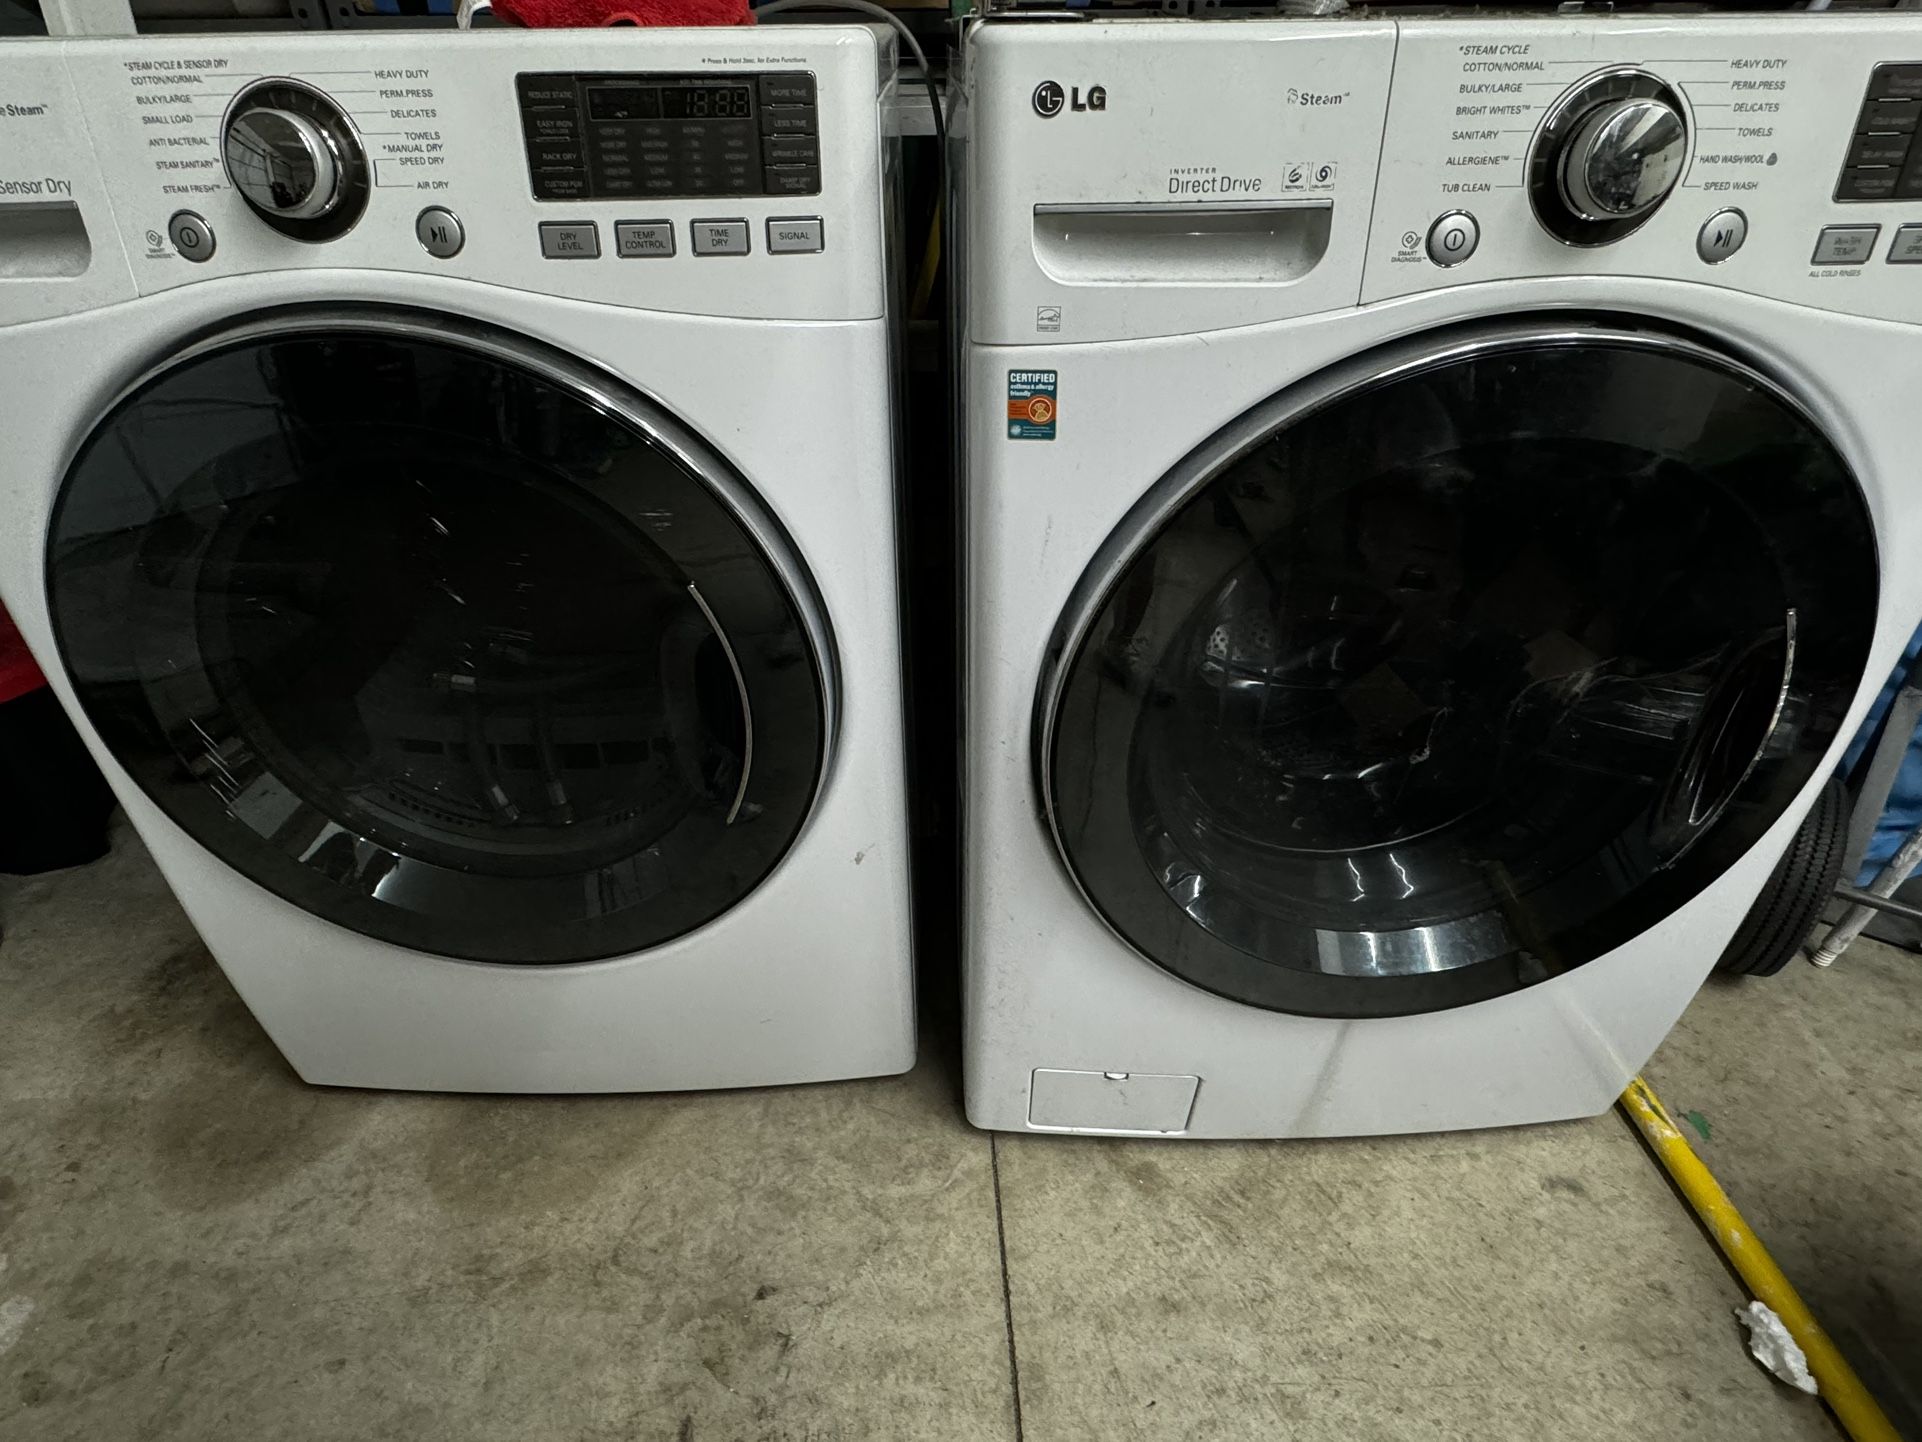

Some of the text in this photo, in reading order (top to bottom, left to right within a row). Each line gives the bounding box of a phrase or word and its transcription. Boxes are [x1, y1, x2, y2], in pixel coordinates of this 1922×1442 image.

[1499, 44, 1531, 55] CYCLE
[153, 60, 175, 70] CYCLE
[184, 59, 213, 70] SENSOR
[214, 58, 228, 69] DRY
[1462, 61, 1545, 72] COTTON/NORMAL
[1730, 59, 1788, 69] HEAVY DUTY
[374, 70, 429, 79] HEAVY DUTY
[131, 74, 204, 86] COTTON/NORMAL
[1459, 82, 1523, 94] BULKY/LARGE
[136, 94, 192, 104] BULKY/LARGE
[1070, 86, 1108, 112] LG
[1456, 106, 1487, 116] BRIGHT
[1733, 102, 1780, 112] DELICATES
[390, 108, 437, 118] DELICATES
[142, 114, 194, 124] SMALL LOAD
[404, 131, 441, 140] TOWELS
[1452, 130, 1500, 140] SANITARY
[1738, 127, 1774, 137] TOWELS
[149, 136, 210, 146] ANTI BACTERIAL
[426, 143, 444, 152] DRY
[398, 156, 444, 166] SPEED DRY
[1699, 154, 1720, 164] HAND
[156, 160, 179, 170] STEAM
[45, 178, 72, 198] Dry
[162, 185, 188, 194] STEAM
[417, 181, 449, 190] AIR DRY
[1168, 176, 1262, 194] Direct Drive
[1442, 183, 1491, 192] TUB CLEAN
[1704, 182, 1758, 190] SPEED WASH
[560, 232, 577, 241] DRY
[632, 230, 656, 240] TEMP
[709, 228, 730, 238] TIME
[778, 231, 810, 241] SIGNAL
[557, 242, 584, 250] LEVEL
[625, 240, 666, 250] CONTROL
[712, 238, 729, 248] DRY
[1808, 270, 1820, 278] ALL
[1010, 373, 1056, 382] CERTIFIED
